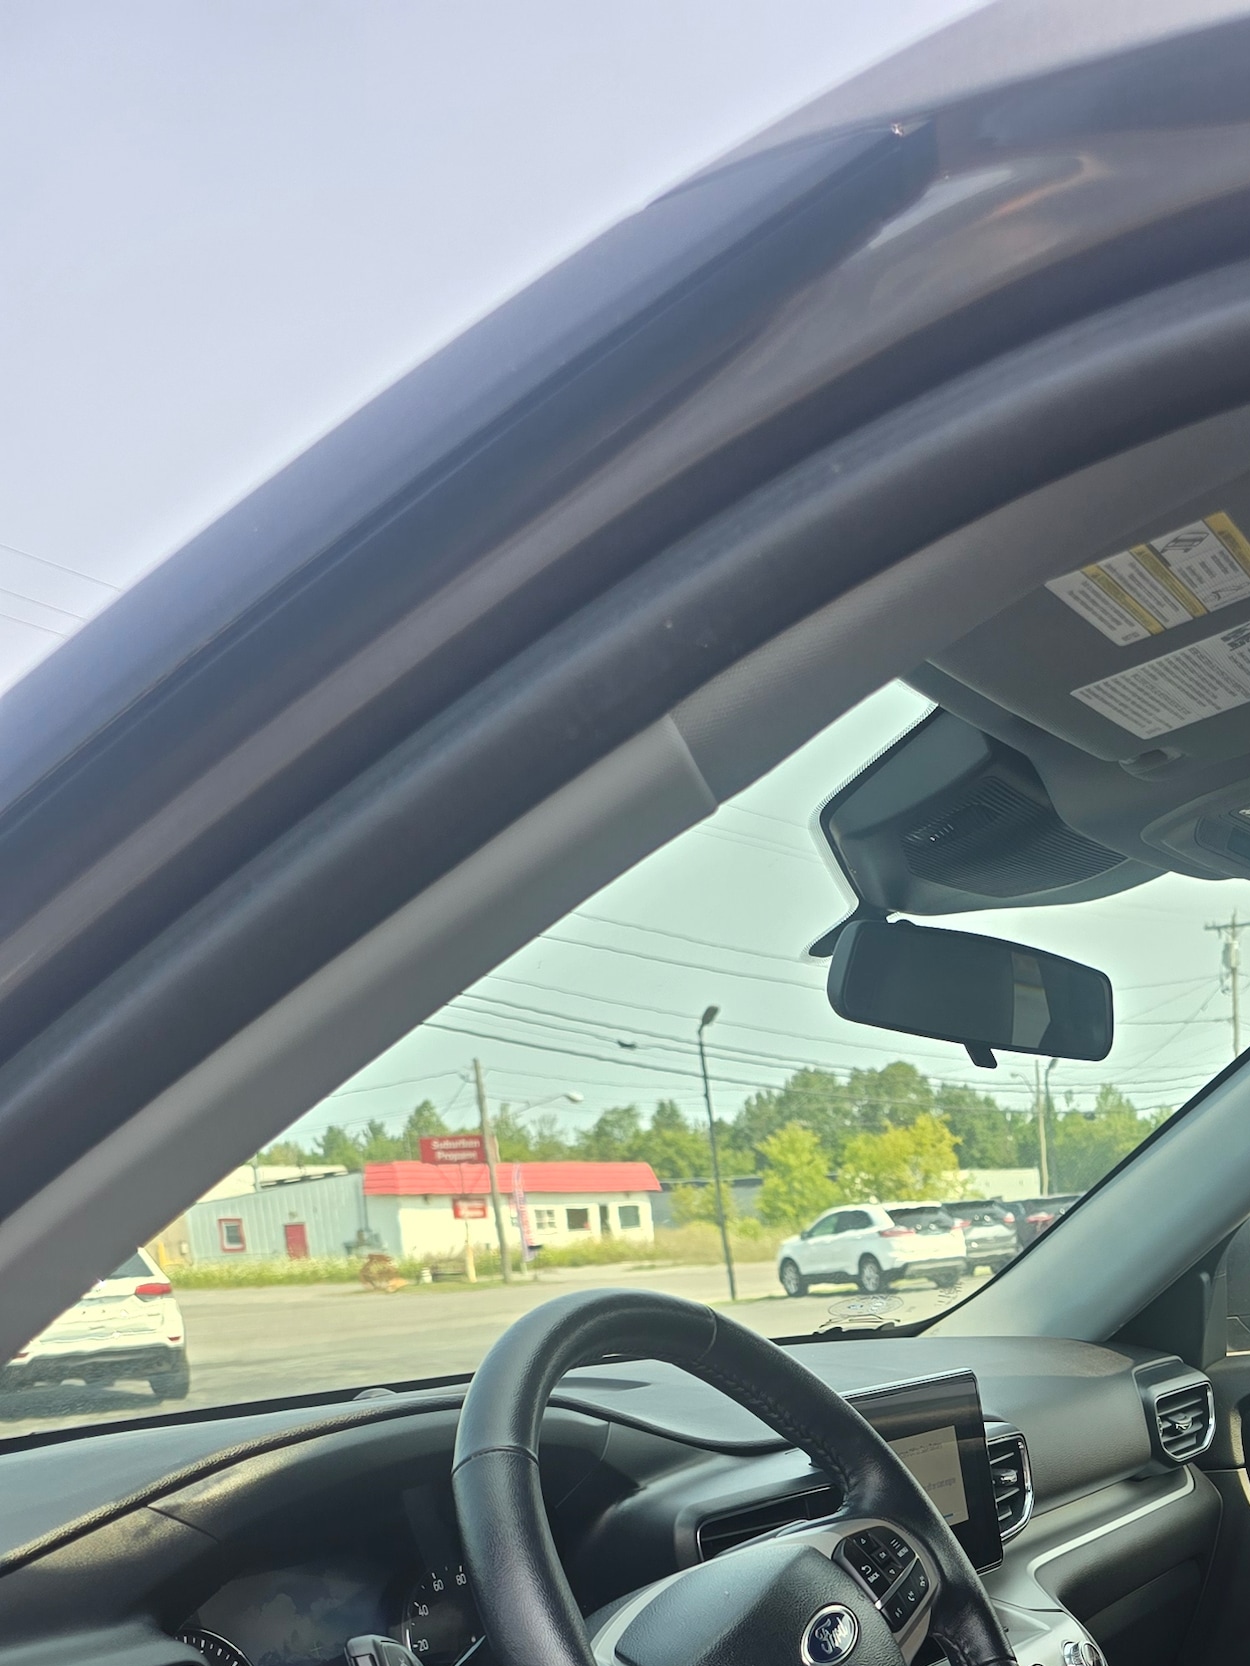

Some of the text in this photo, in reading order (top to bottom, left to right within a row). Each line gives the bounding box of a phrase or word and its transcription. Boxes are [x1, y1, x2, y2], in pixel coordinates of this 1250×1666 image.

[432, 1579, 444, 1592] 60
[455, 1573, 467, 1586] 80
[418, 1604, 429, 1616] 40
[814, 1616, 848, 1655] Ford
[417, 1638, 429, 1651] 20
